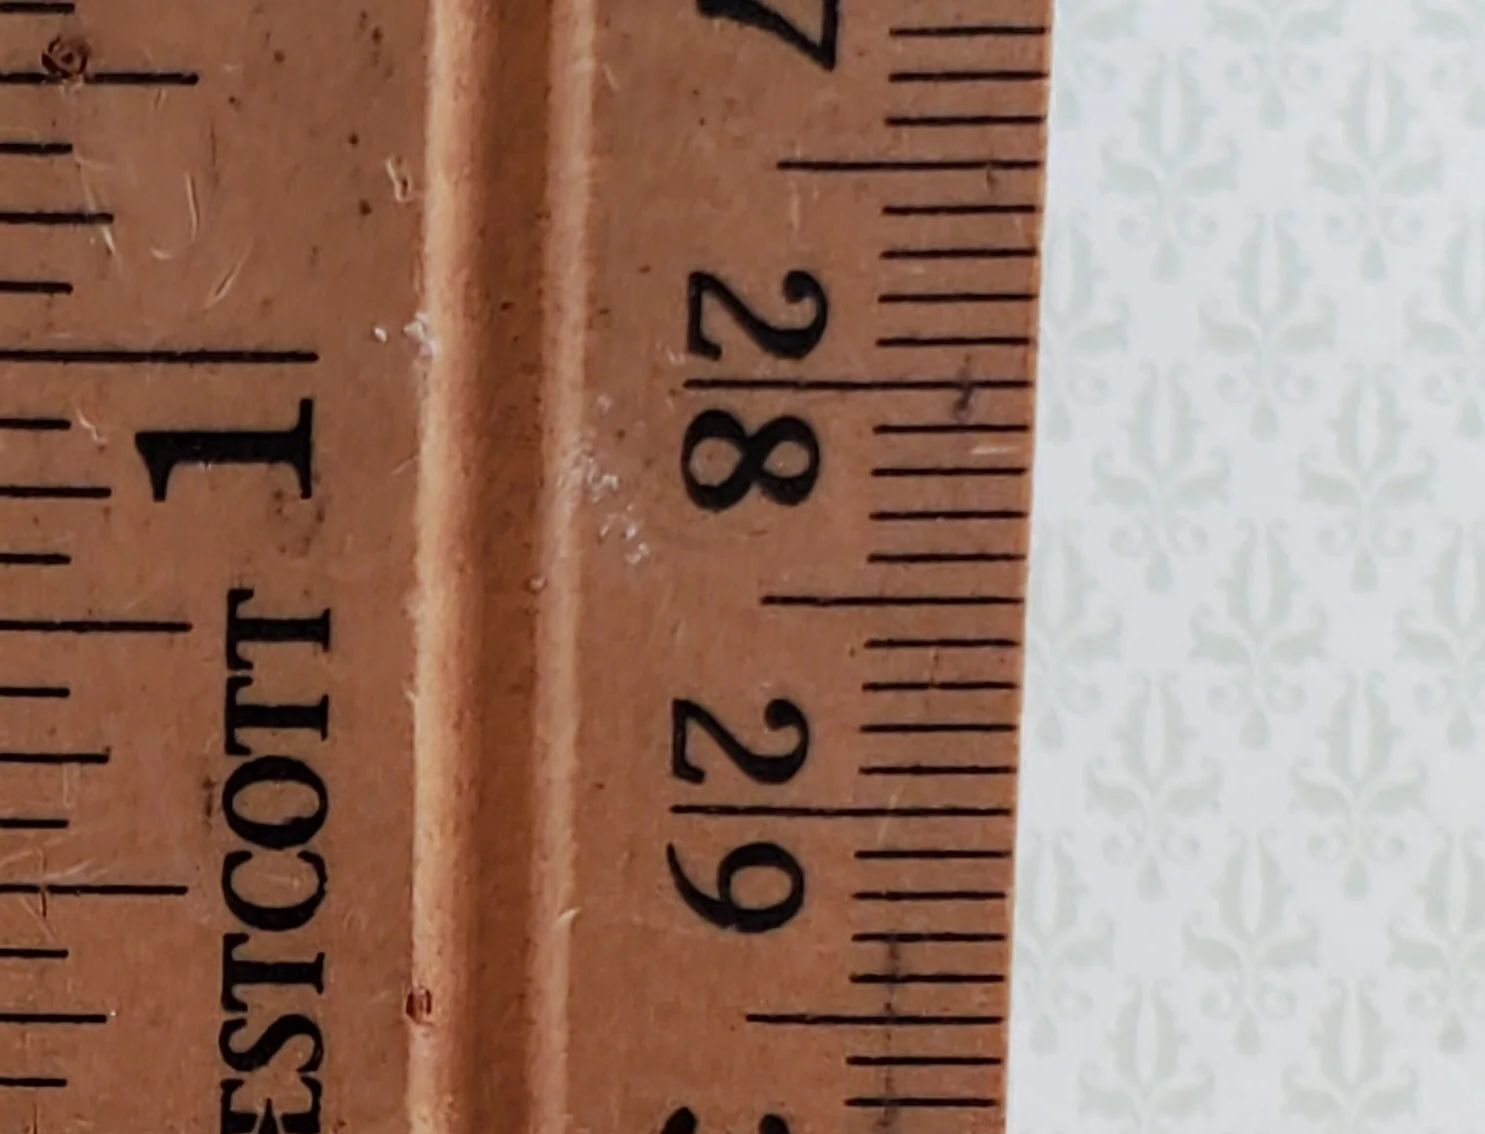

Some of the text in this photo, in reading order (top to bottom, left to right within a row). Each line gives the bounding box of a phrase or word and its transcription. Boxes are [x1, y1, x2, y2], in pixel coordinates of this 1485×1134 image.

[133, 396, 321, 503] 1
[678, 269, 832, 514] 28
[664, 697, 812, 936] 29
